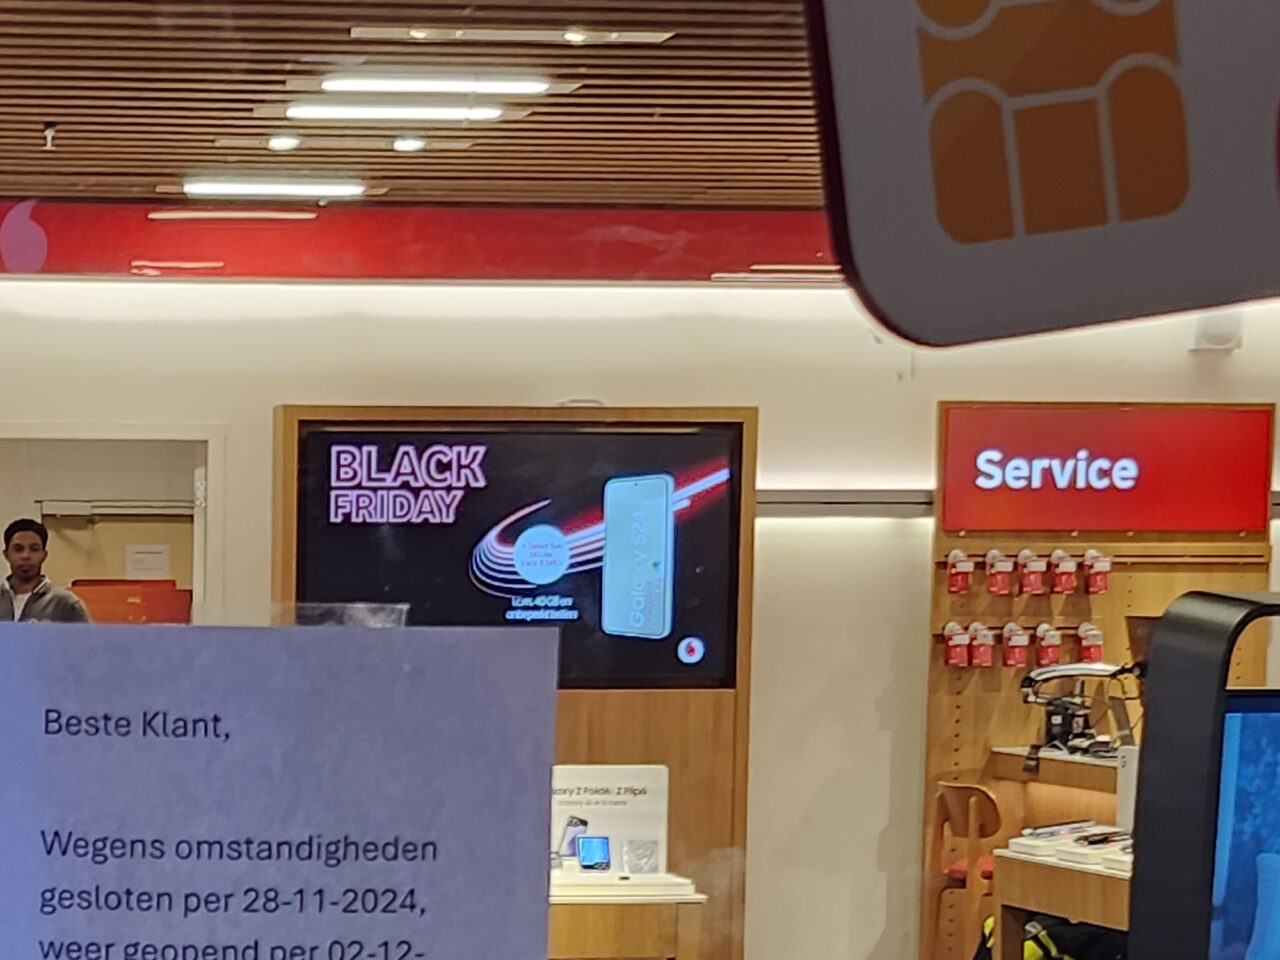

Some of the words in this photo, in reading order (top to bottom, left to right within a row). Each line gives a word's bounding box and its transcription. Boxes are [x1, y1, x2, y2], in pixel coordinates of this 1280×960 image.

[330, 444, 486, 488] BLACK
[975, 448, 1138, 491] Service
[330, 489, 463, 523] FRIDAY
[629, 549, 648, 628] Galaxy
[44, 708, 131, 737] Beste
[143, 710, 231, 742] Klant,
[40, 830, 165, 865] Wegens
[175, 834, 438, 868] omstandigheden
[40, 885, 173, 915] gesloten
[184, 892, 234, 918] per
[242, 887, 426, 917] 28-11-2024,
